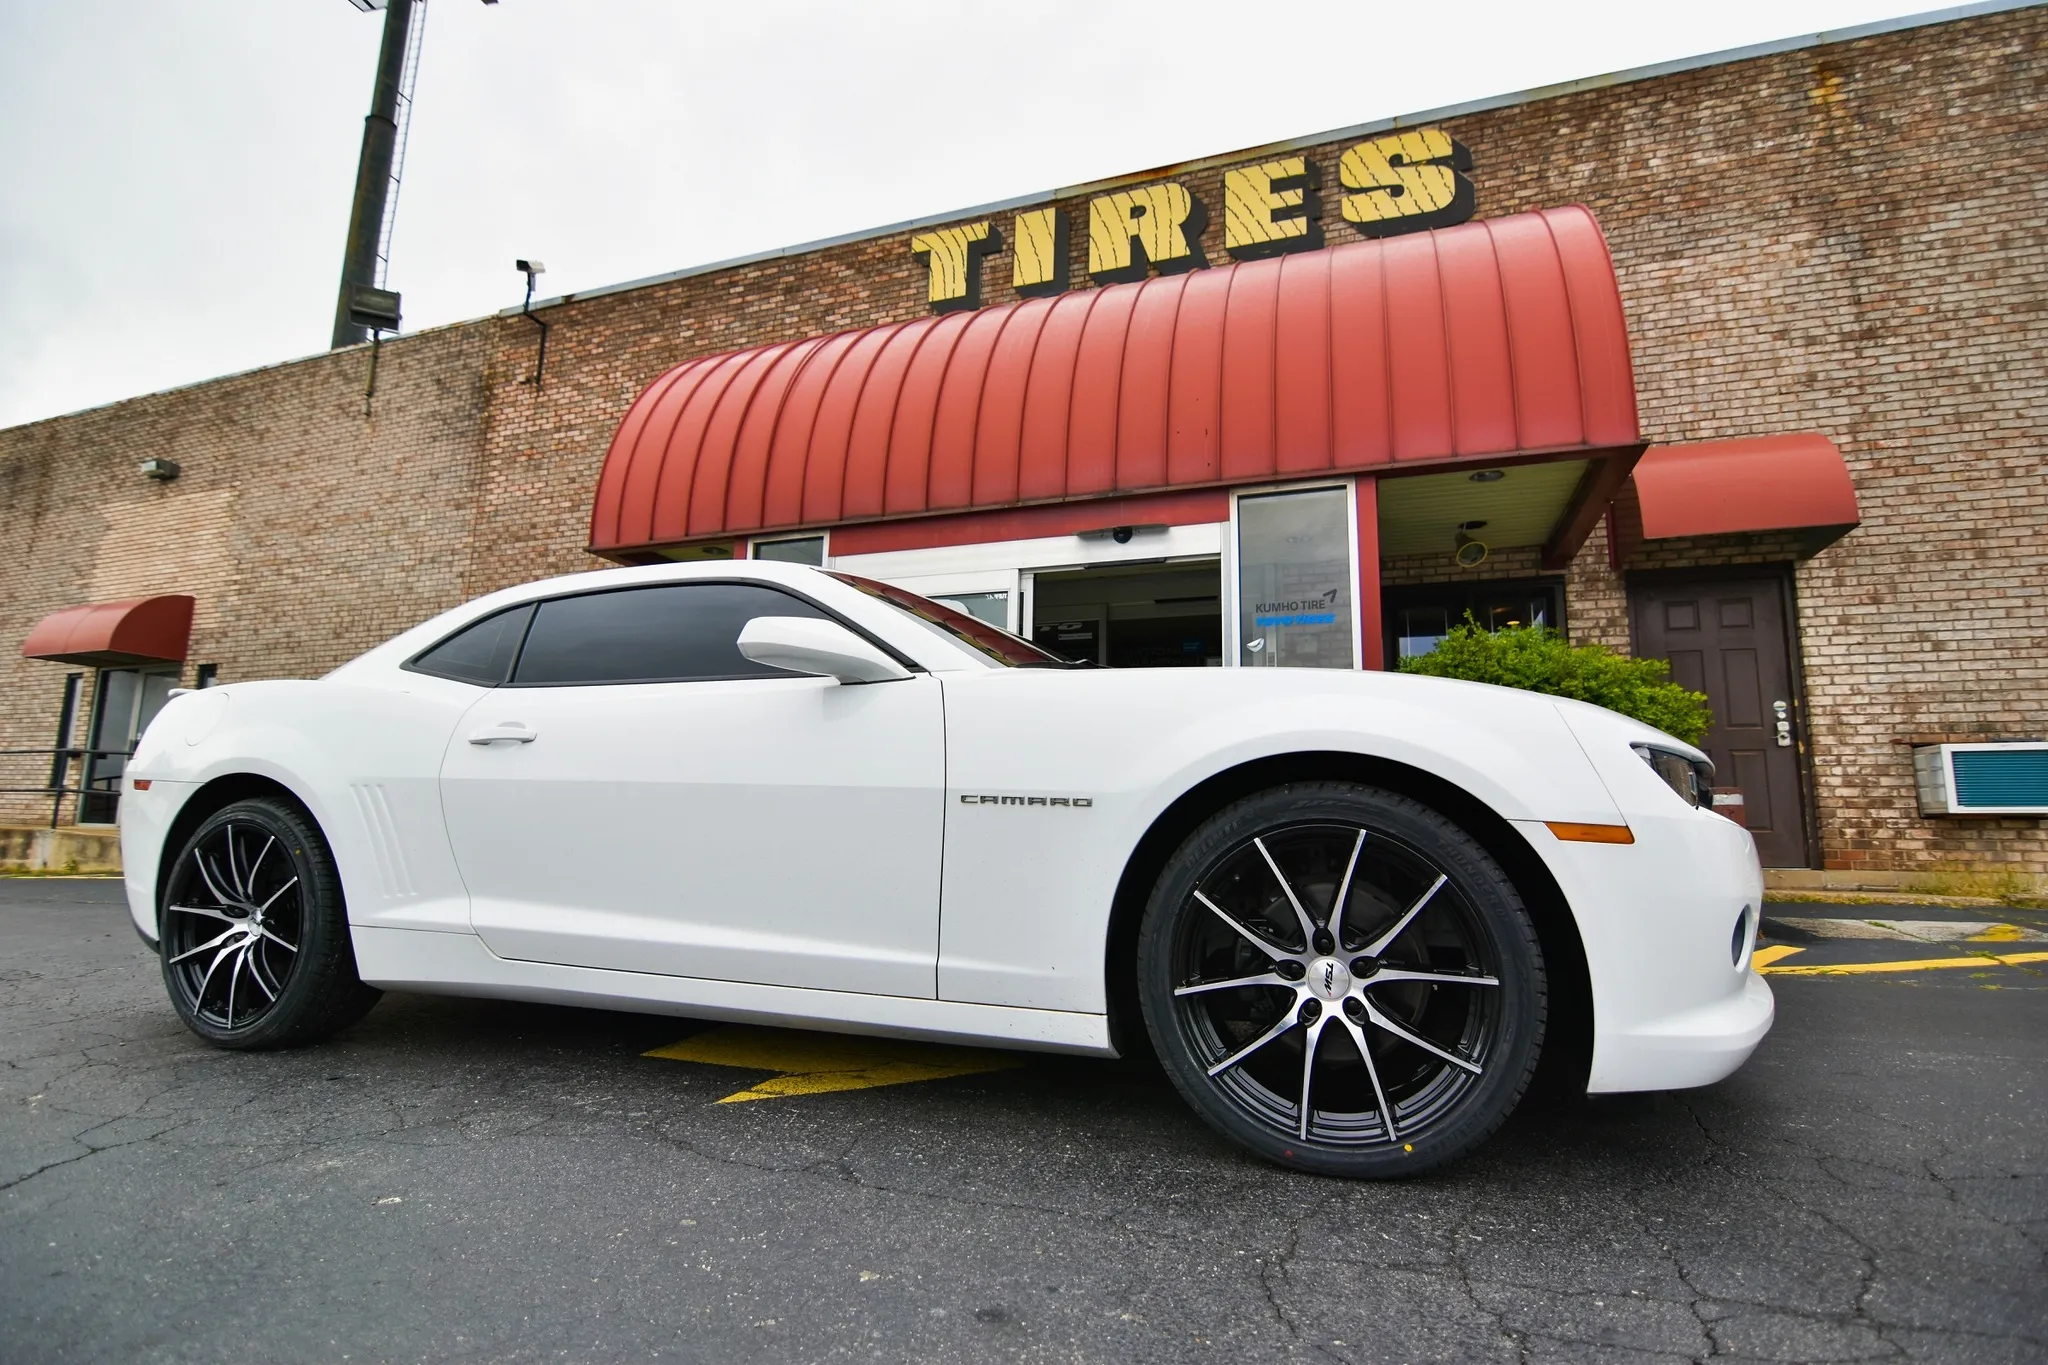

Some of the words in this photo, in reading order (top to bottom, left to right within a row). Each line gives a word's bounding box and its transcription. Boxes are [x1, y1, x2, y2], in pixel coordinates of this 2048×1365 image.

[912, 129, 1474, 313] TIRES
[1255, 600, 1299, 614] KUMHO
[1300, 599, 1326, 611] TIRE
[960, 794, 1093, 808] CAMARO
[1436, 837, 1499, 905] THUNDER
[1324, 962, 1334, 997] TSW
